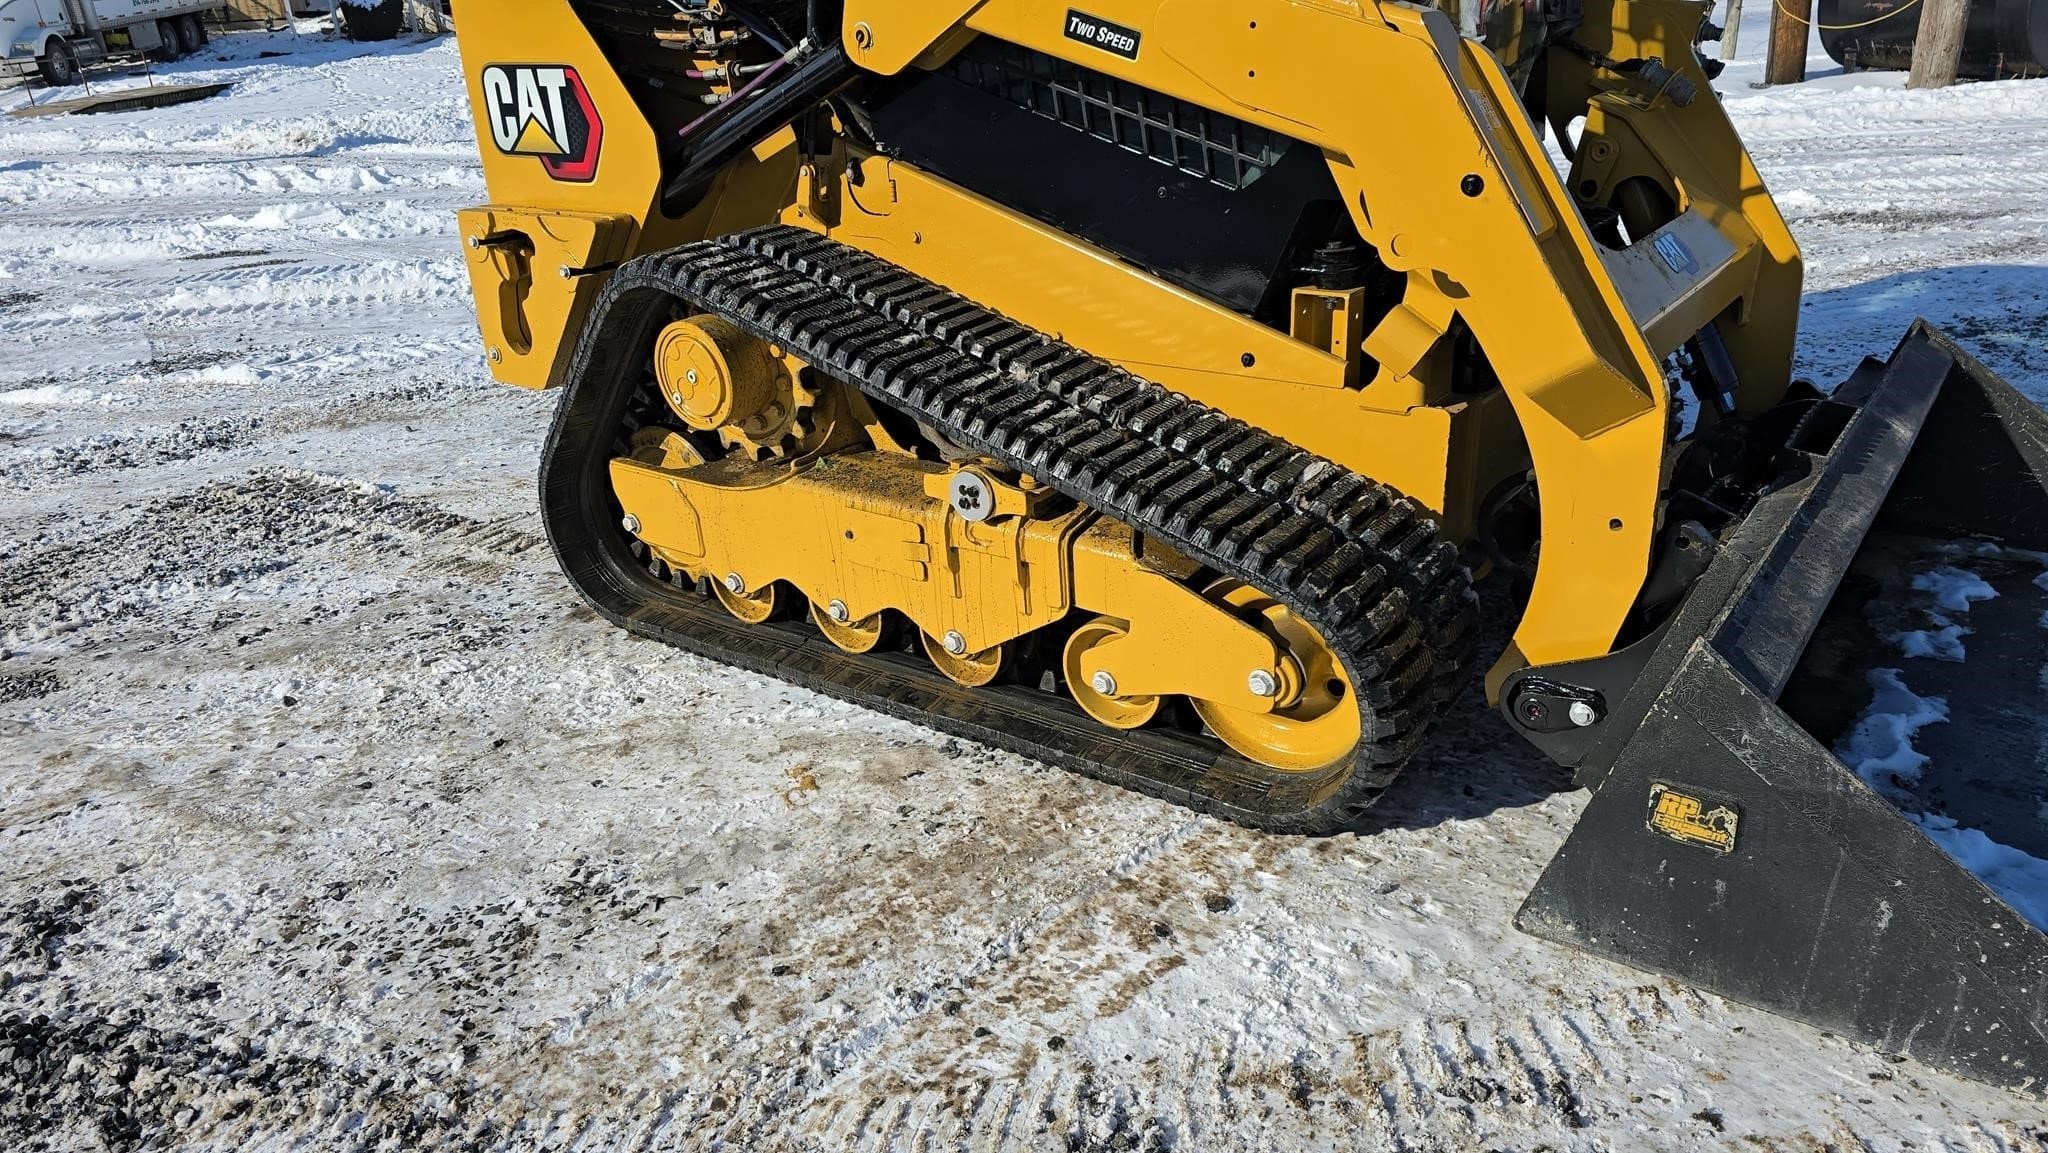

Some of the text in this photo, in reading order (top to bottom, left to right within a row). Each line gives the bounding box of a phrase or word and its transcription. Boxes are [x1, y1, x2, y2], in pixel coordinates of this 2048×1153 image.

[1069, 16, 1135, 52] TWO SPEED
[483, 67, 570, 154] CAT
[1654, 232, 1690, 273] CAT
[1658, 790, 1699, 818] RP
